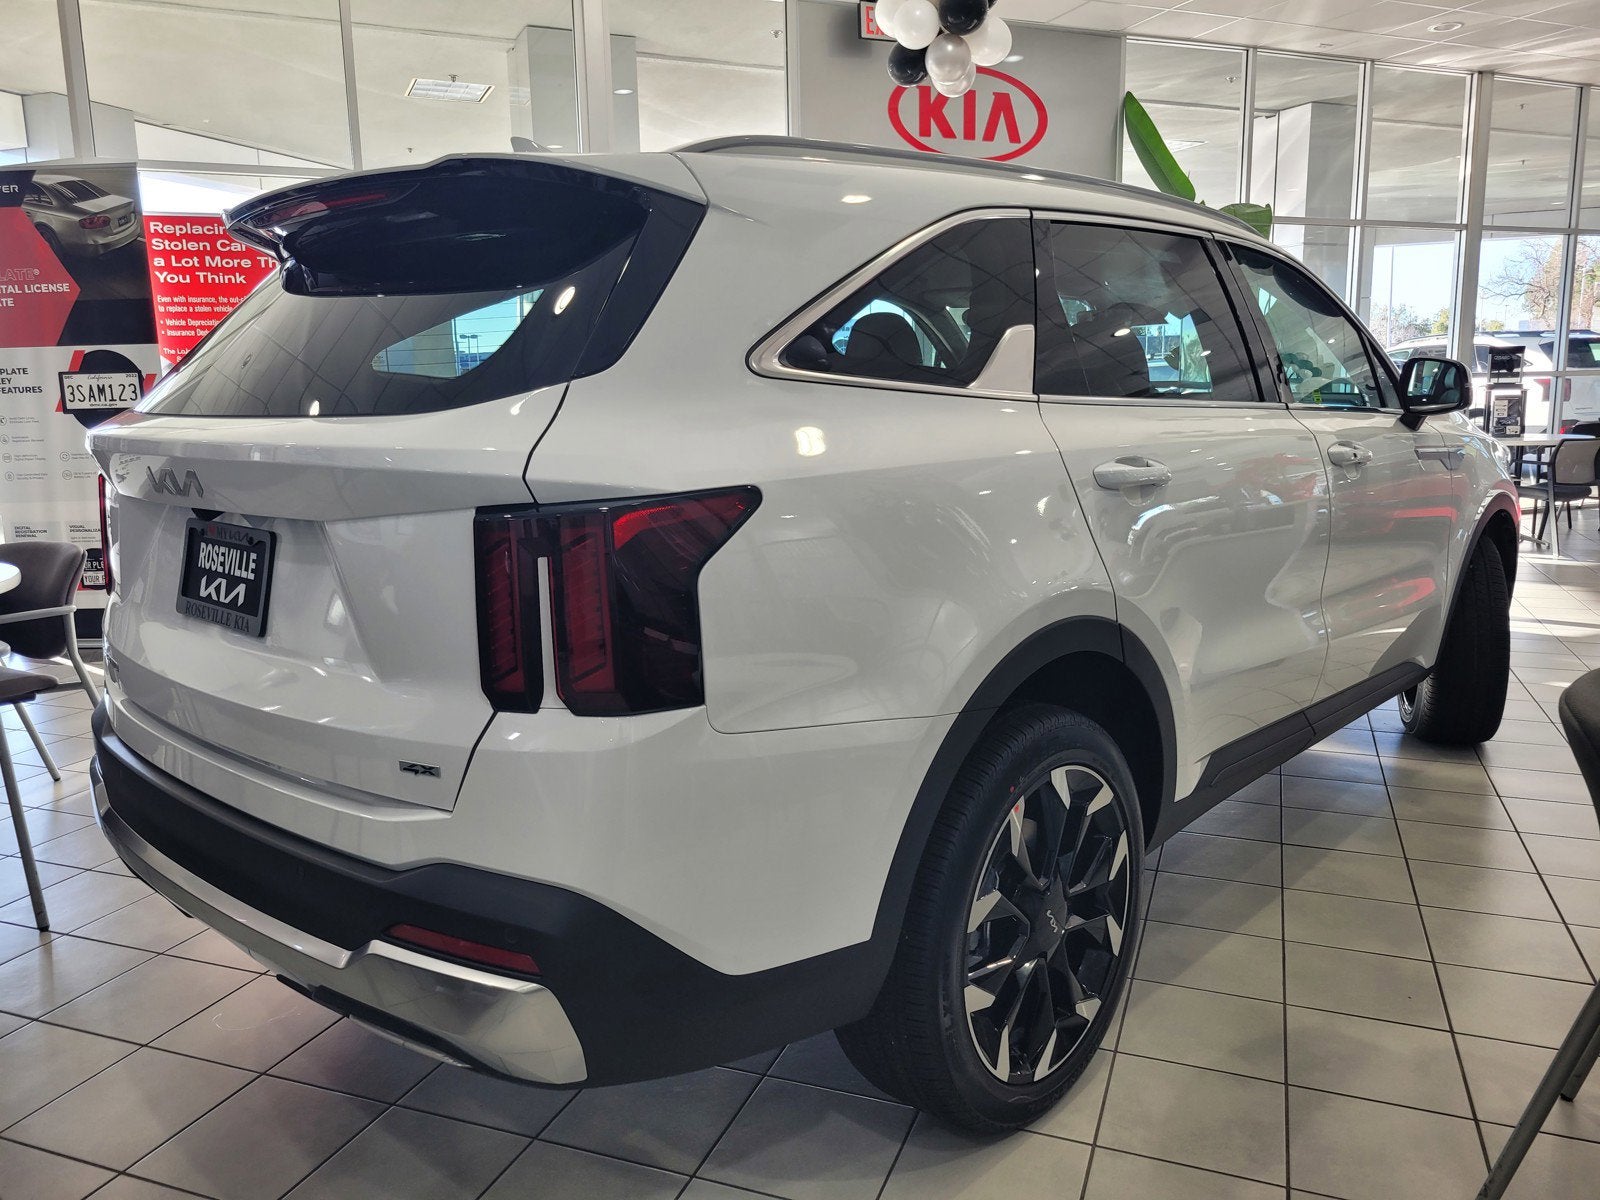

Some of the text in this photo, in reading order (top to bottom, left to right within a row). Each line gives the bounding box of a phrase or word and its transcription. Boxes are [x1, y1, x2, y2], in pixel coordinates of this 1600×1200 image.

[916, 84, 1022, 144] KIA
[151, 237, 246, 252] Stolen Car
[153, 255, 279, 269] a Lot More Th
[153, 271, 247, 284] You Think
[0, 283, 71, 294] TAL LICENSE
[157, 294, 172, 303] Even
[173, 295, 186, 303] with
[187, 295, 218, 304] insurance,
[158, 305, 165, 313] to
[166, 305, 187, 313] replace
[165, 318, 186, 326] Vehicle
[162, 347, 176, 355] The
[66, 383, 138, 403] 3SAM123
[145, 465, 204, 498] KIA
[198, 541, 258, 580] ROSEVILLE
[199, 575, 247, 608] KIA
[184, 600, 250, 633] ROSEVILLE KIA
